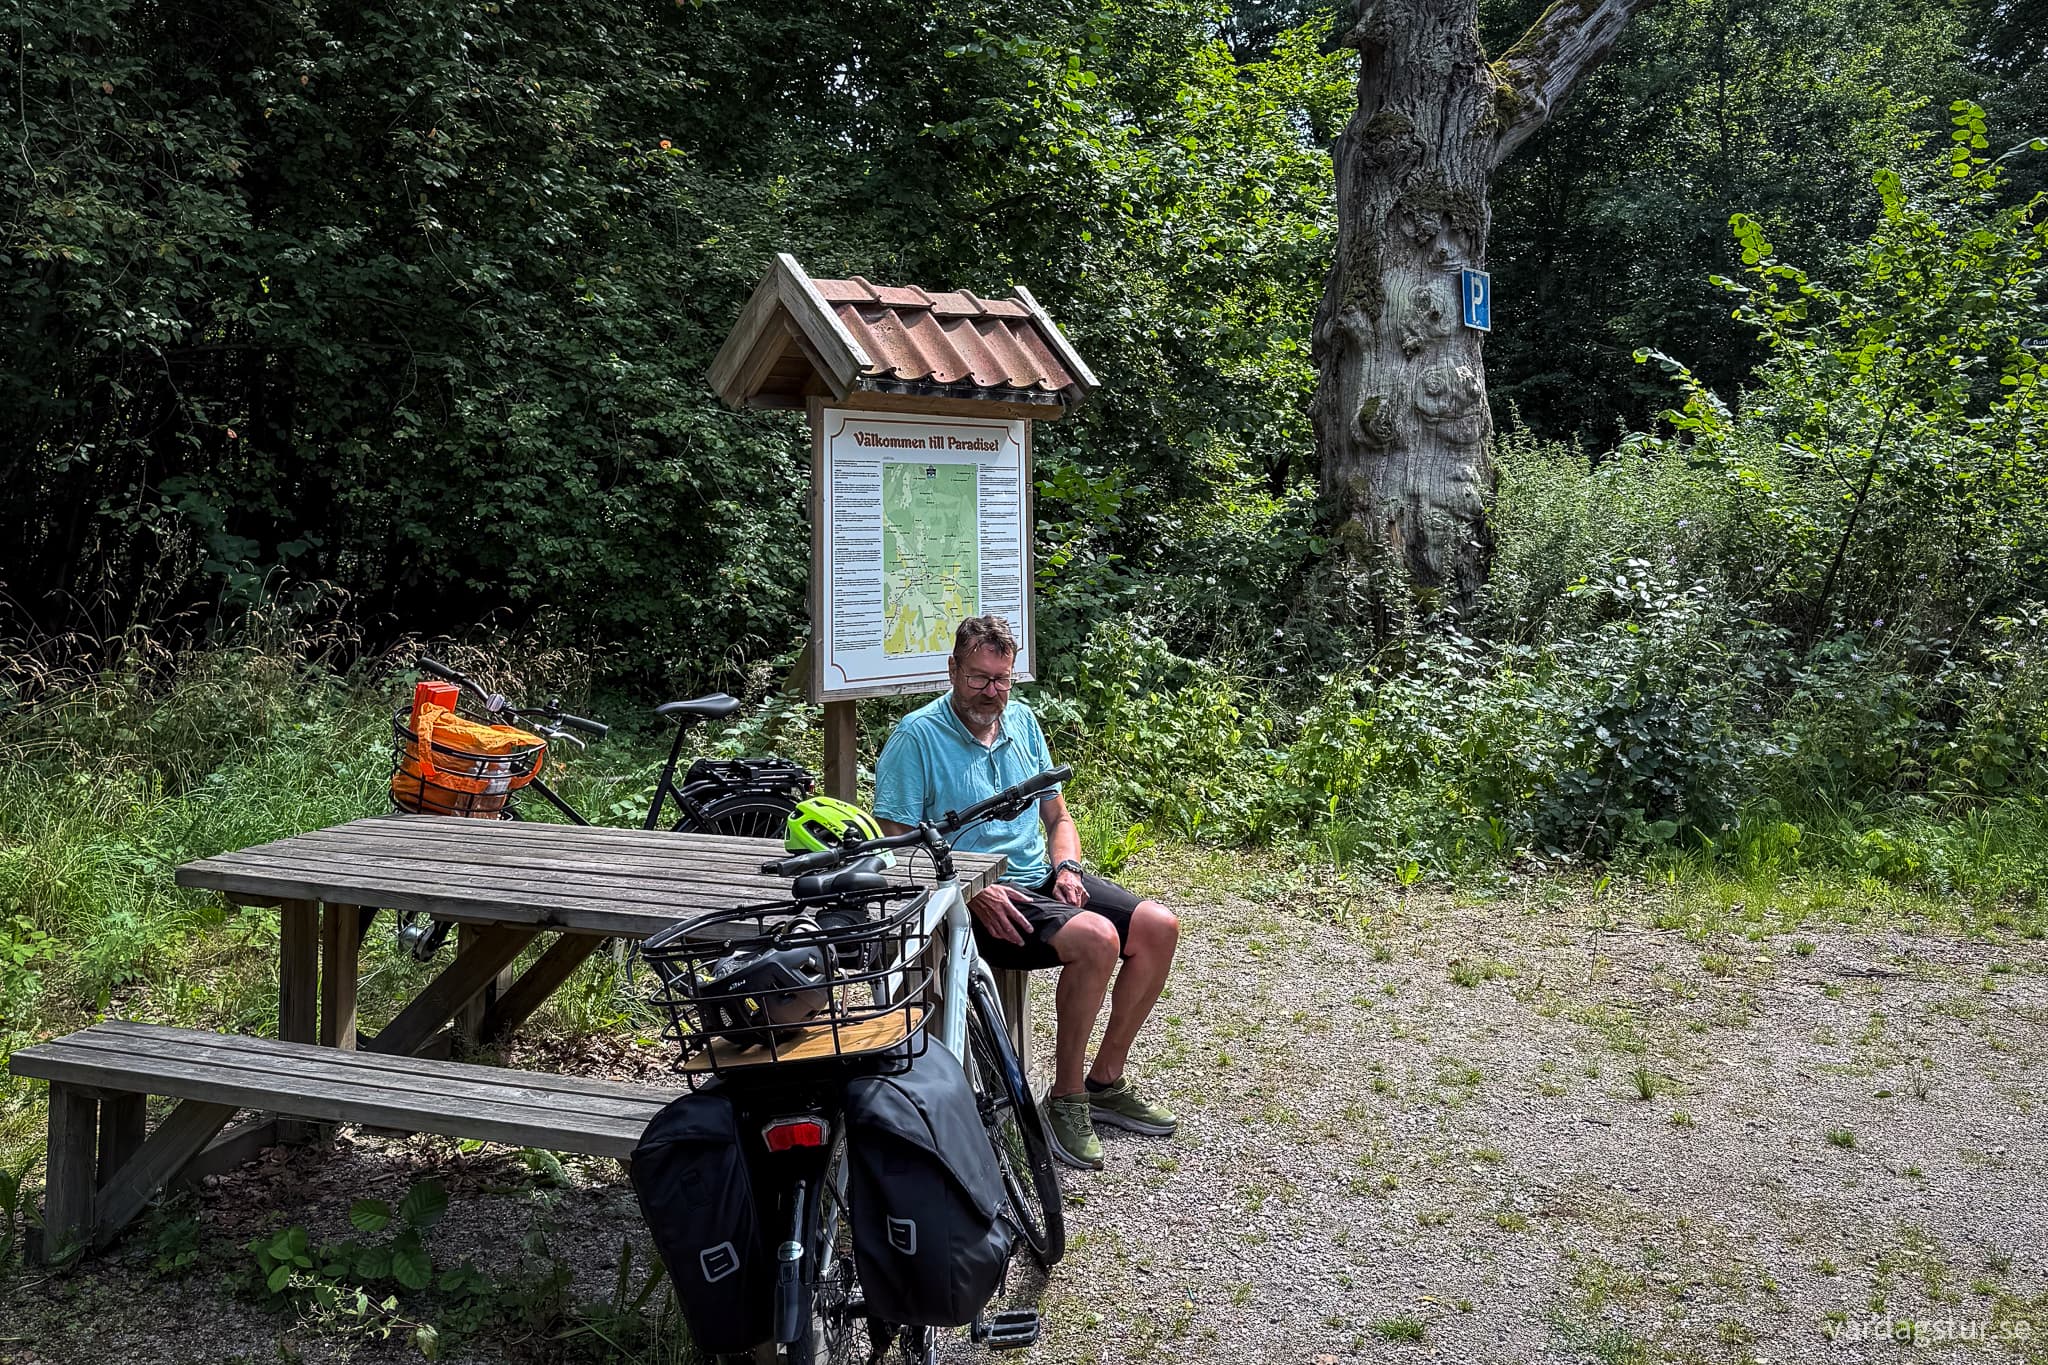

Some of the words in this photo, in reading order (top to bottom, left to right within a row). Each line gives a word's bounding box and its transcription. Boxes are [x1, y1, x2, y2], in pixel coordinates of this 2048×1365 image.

[1471, 277, 1484, 321] P
[854, 431, 926, 449] Välkommen
[929, 436, 945, 450] till
[947, 437, 999, 452] Paradiset
